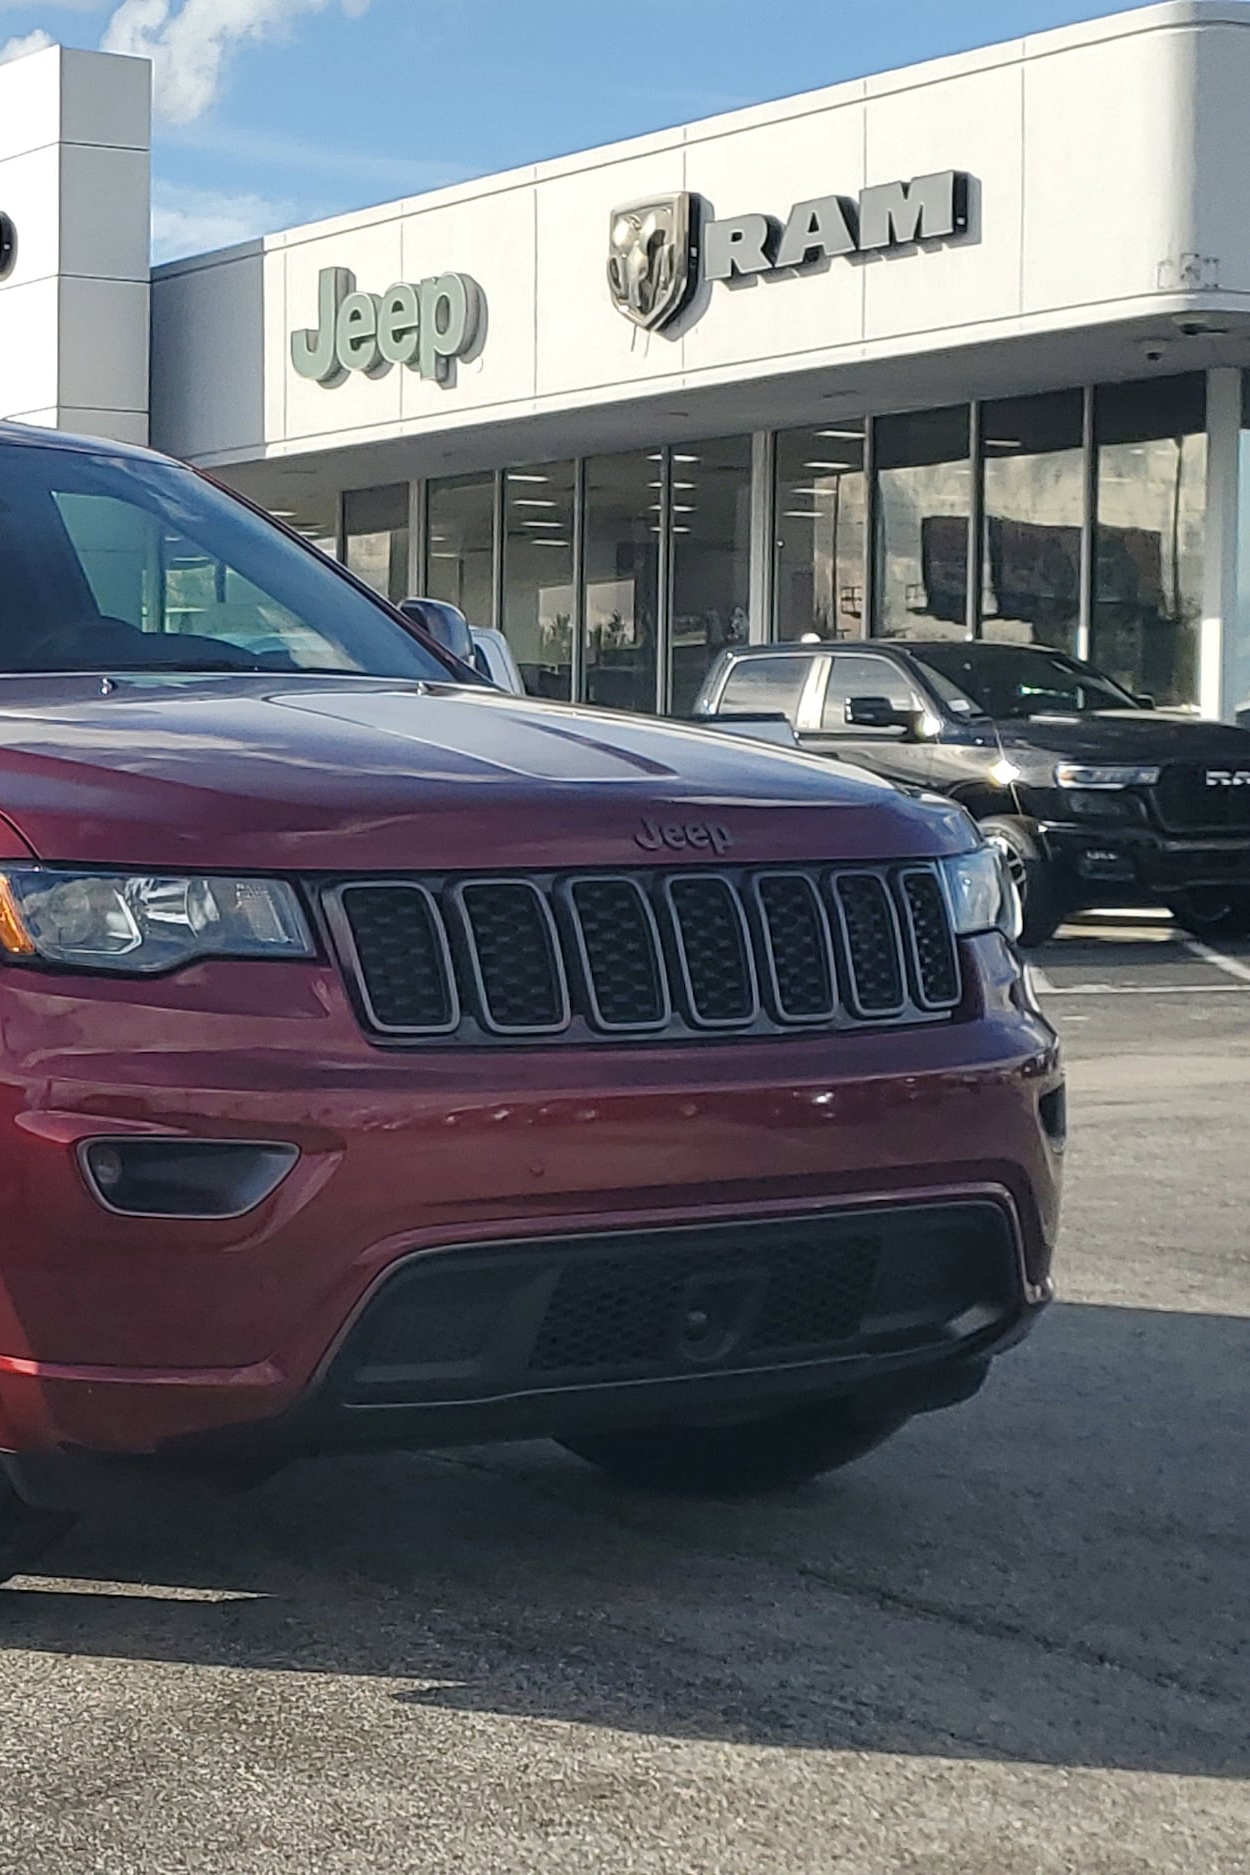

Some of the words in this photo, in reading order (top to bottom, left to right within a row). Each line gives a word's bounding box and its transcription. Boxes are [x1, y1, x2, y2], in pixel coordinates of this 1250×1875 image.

[704, 170, 979, 289] RAM
[290, 266, 485, 387] Jeep
[1205, 771, 1250, 786] RA
[633, 815, 734, 856] Jeep
